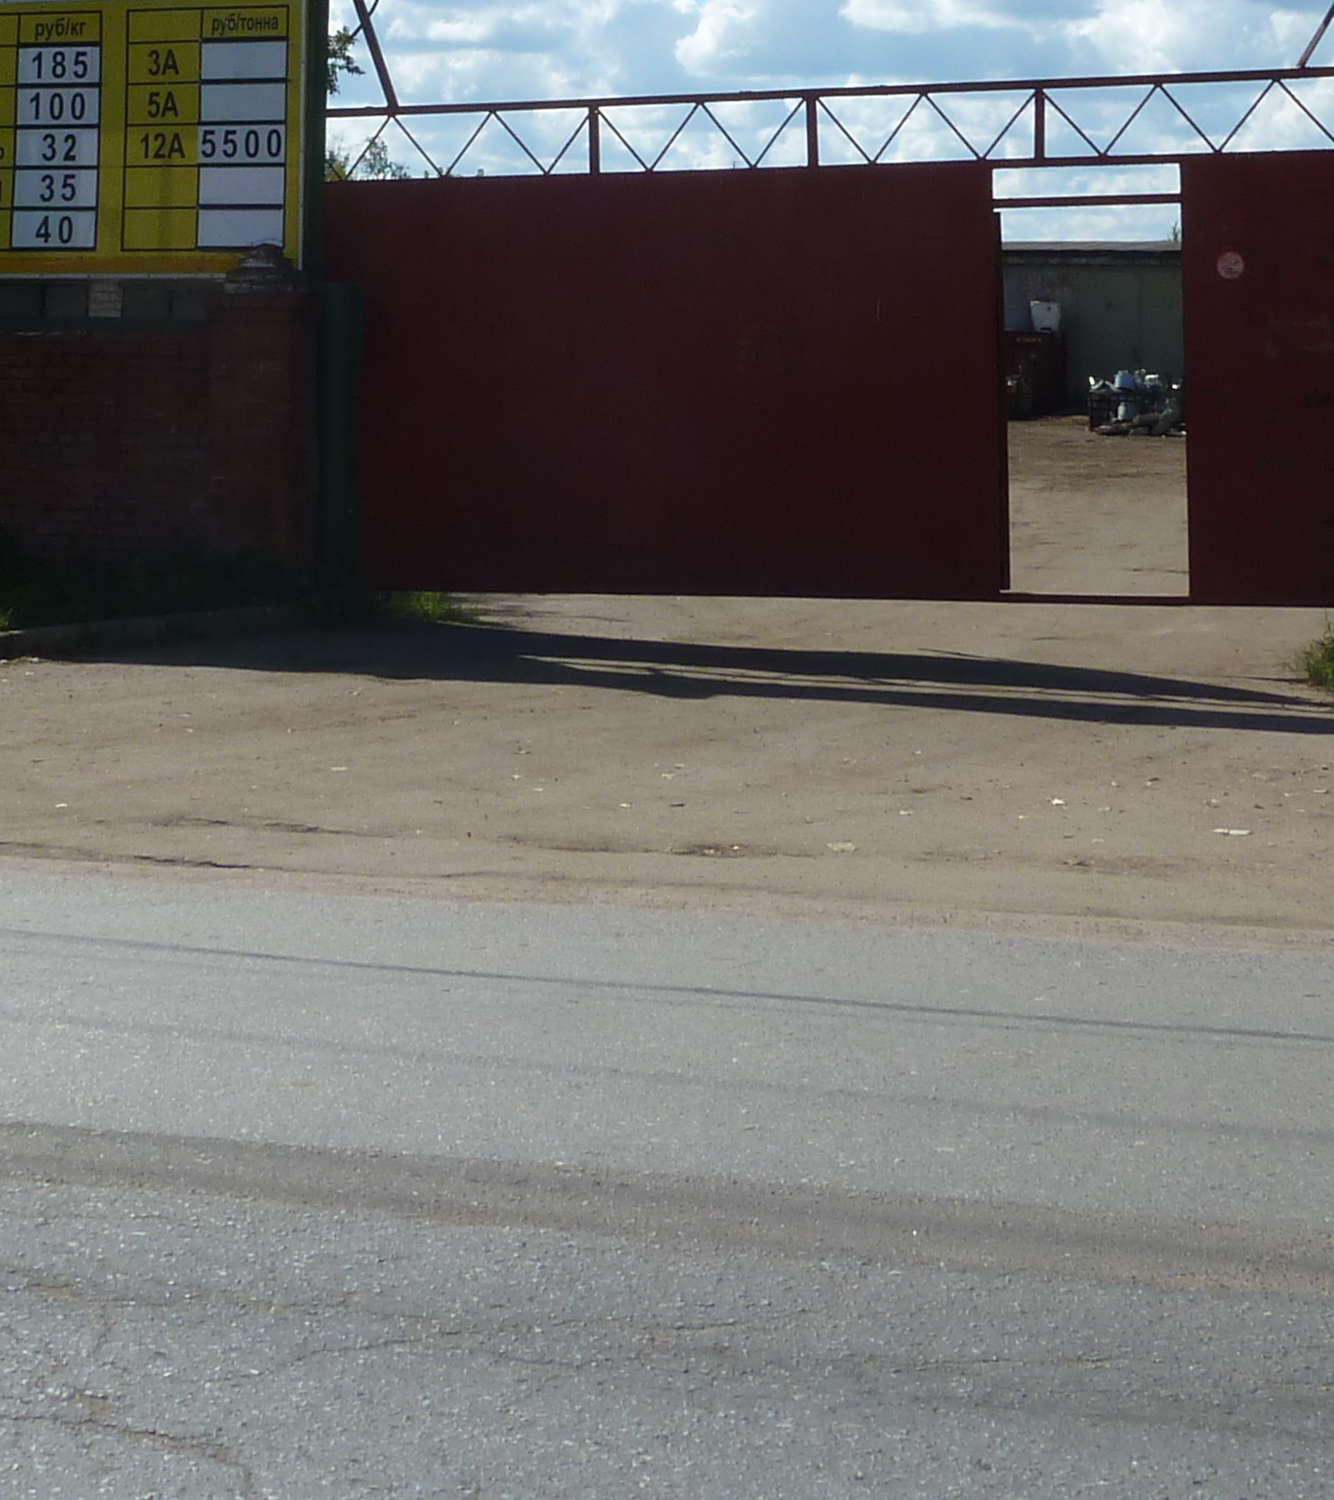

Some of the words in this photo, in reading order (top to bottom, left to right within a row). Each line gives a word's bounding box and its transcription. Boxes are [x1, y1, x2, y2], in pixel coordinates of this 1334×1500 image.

[34, 18, 87, 41] руб/кг
[211, 14, 279, 35] руб/тонна
[31, 51, 88, 79] 185
[29, 92, 86, 121] 100
[147, 92, 179, 118] 5А
[41, 133, 77, 162] 32
[140, 133, 186, 160] 12А
[200, 129, 282, 158] 5500
[40, 174, 77, 202] 35
[35, 216, 74, 244] 40
